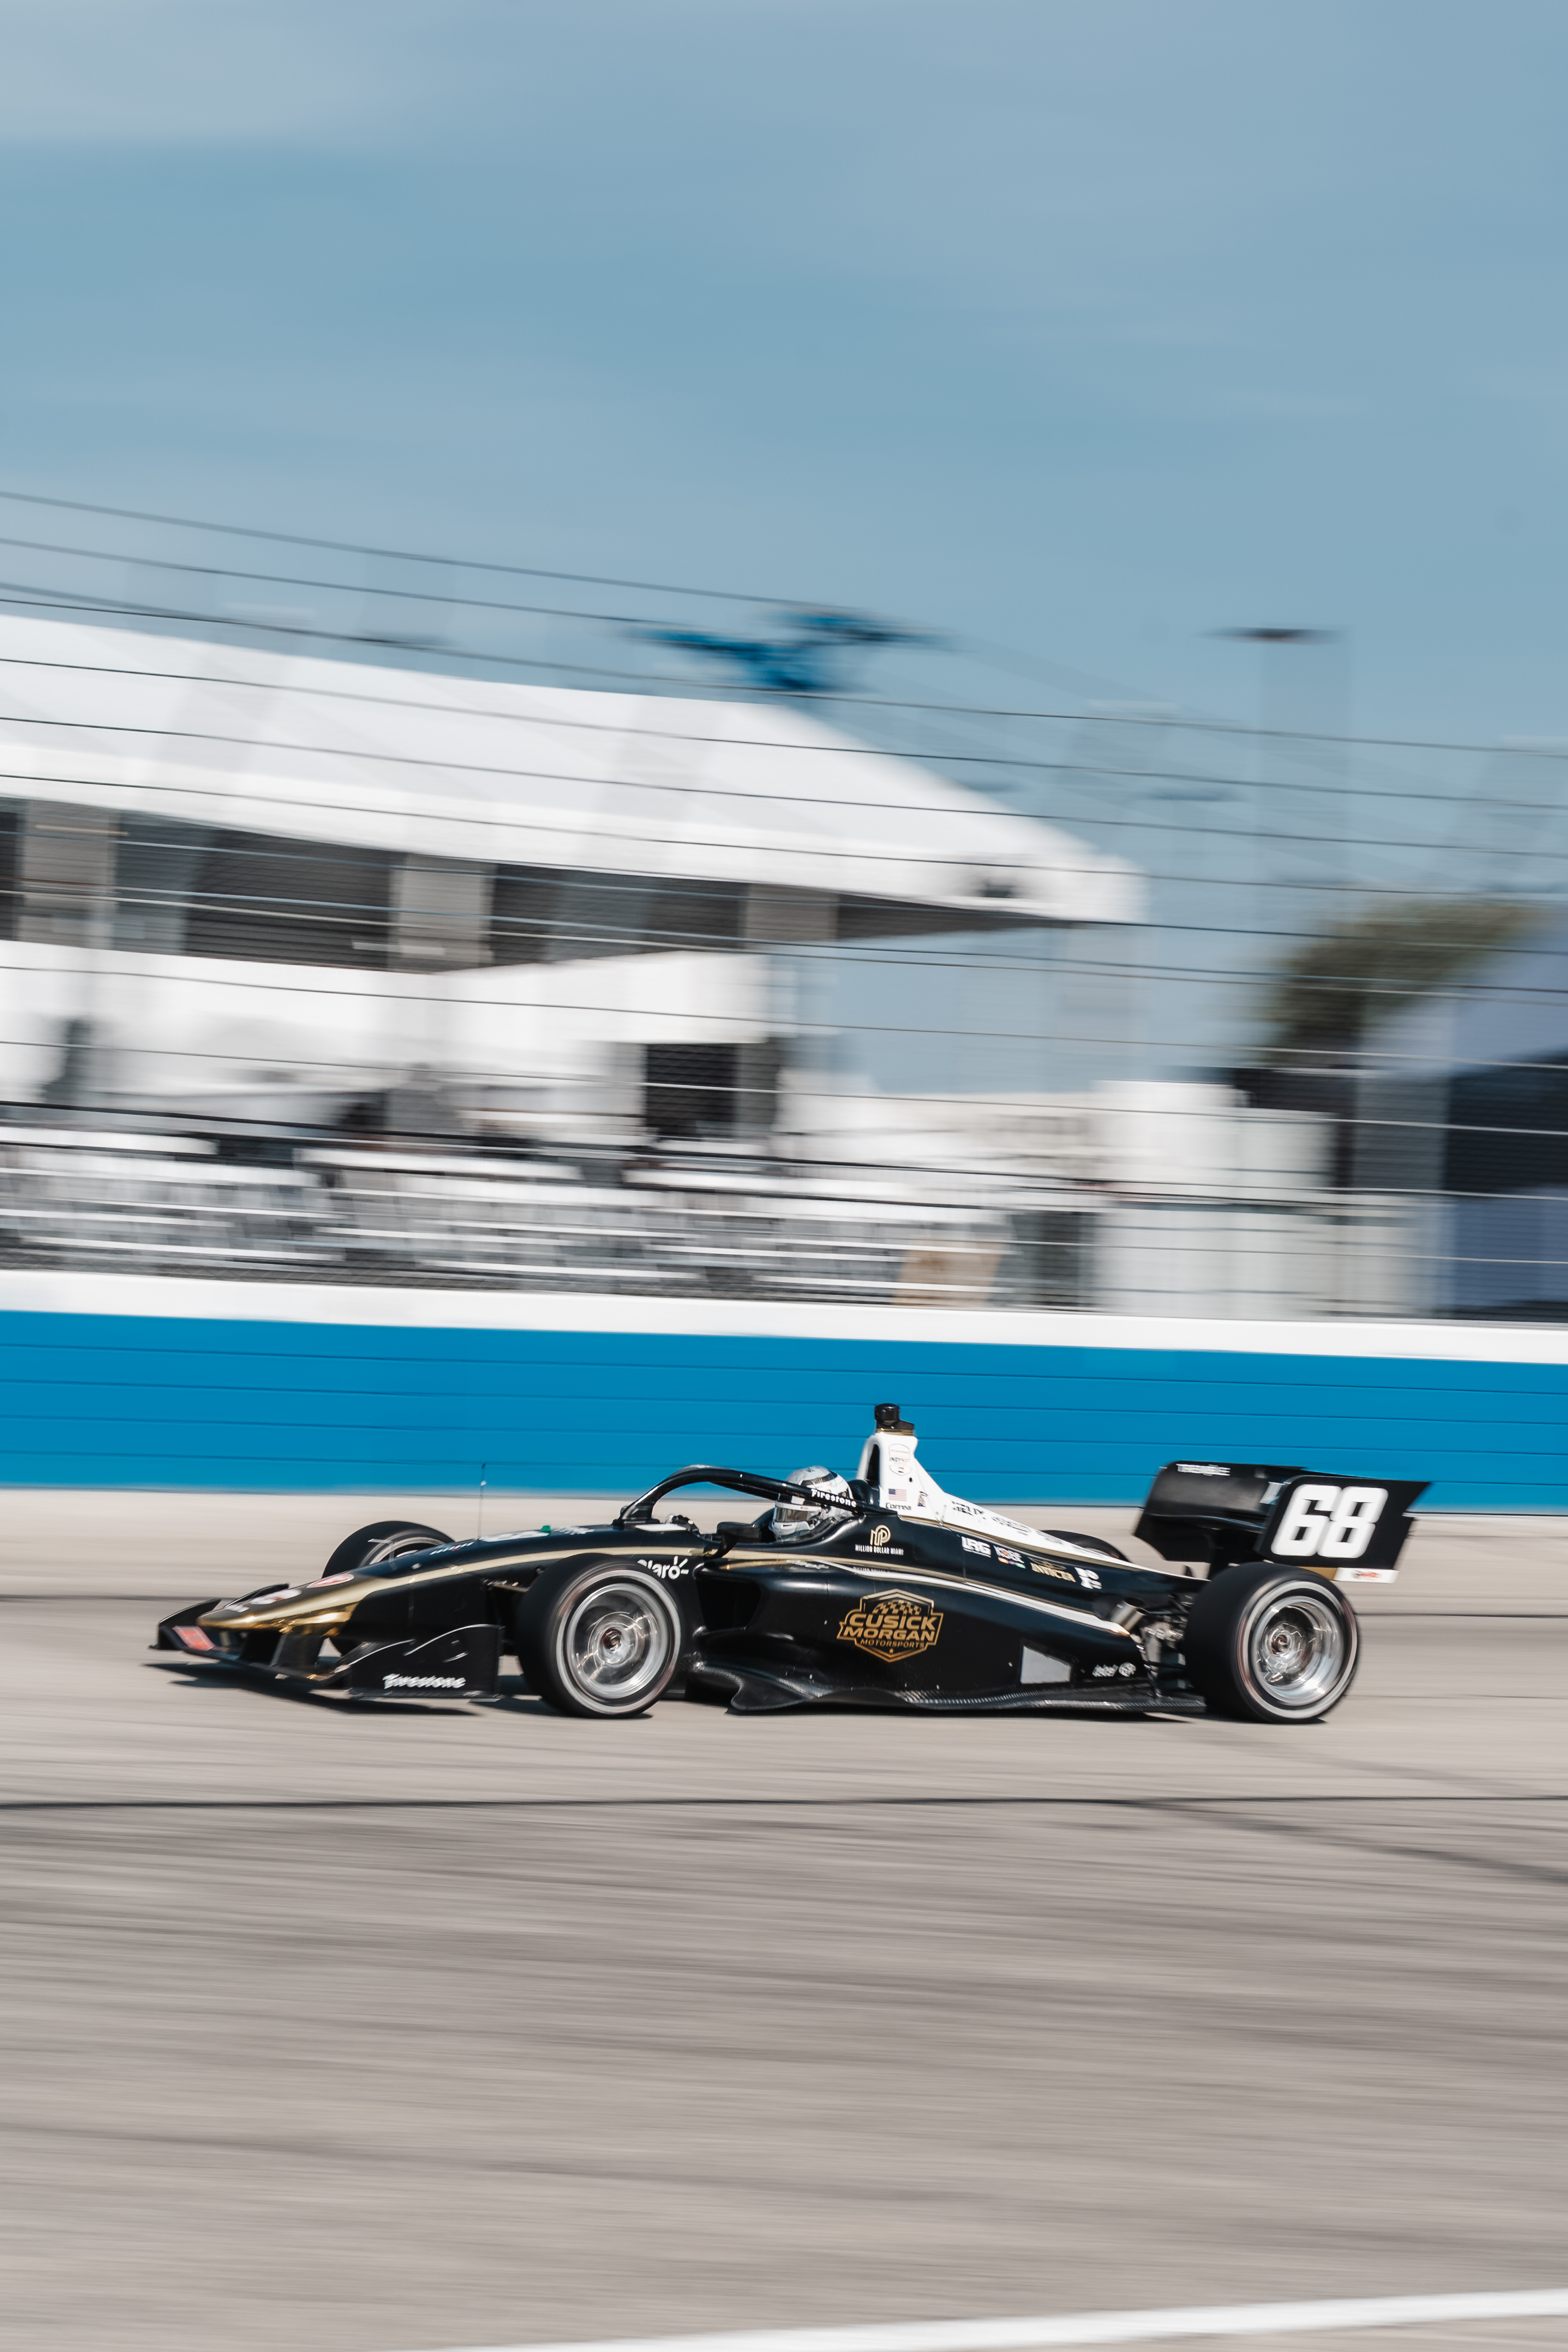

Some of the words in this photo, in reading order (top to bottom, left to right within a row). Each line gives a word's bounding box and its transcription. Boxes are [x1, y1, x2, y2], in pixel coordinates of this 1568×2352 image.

[811, 1488, 857, 1508] Firestone
[886, 1502, 911, 1511] Correa
[1271, 1484, 1389, 1558] 68
[849, 1613, 937, 1630] CUSICK
[843, 1626, 935, 1642] MORGAN
[860, 1638, 925, 1649] MOTORSPORTS
